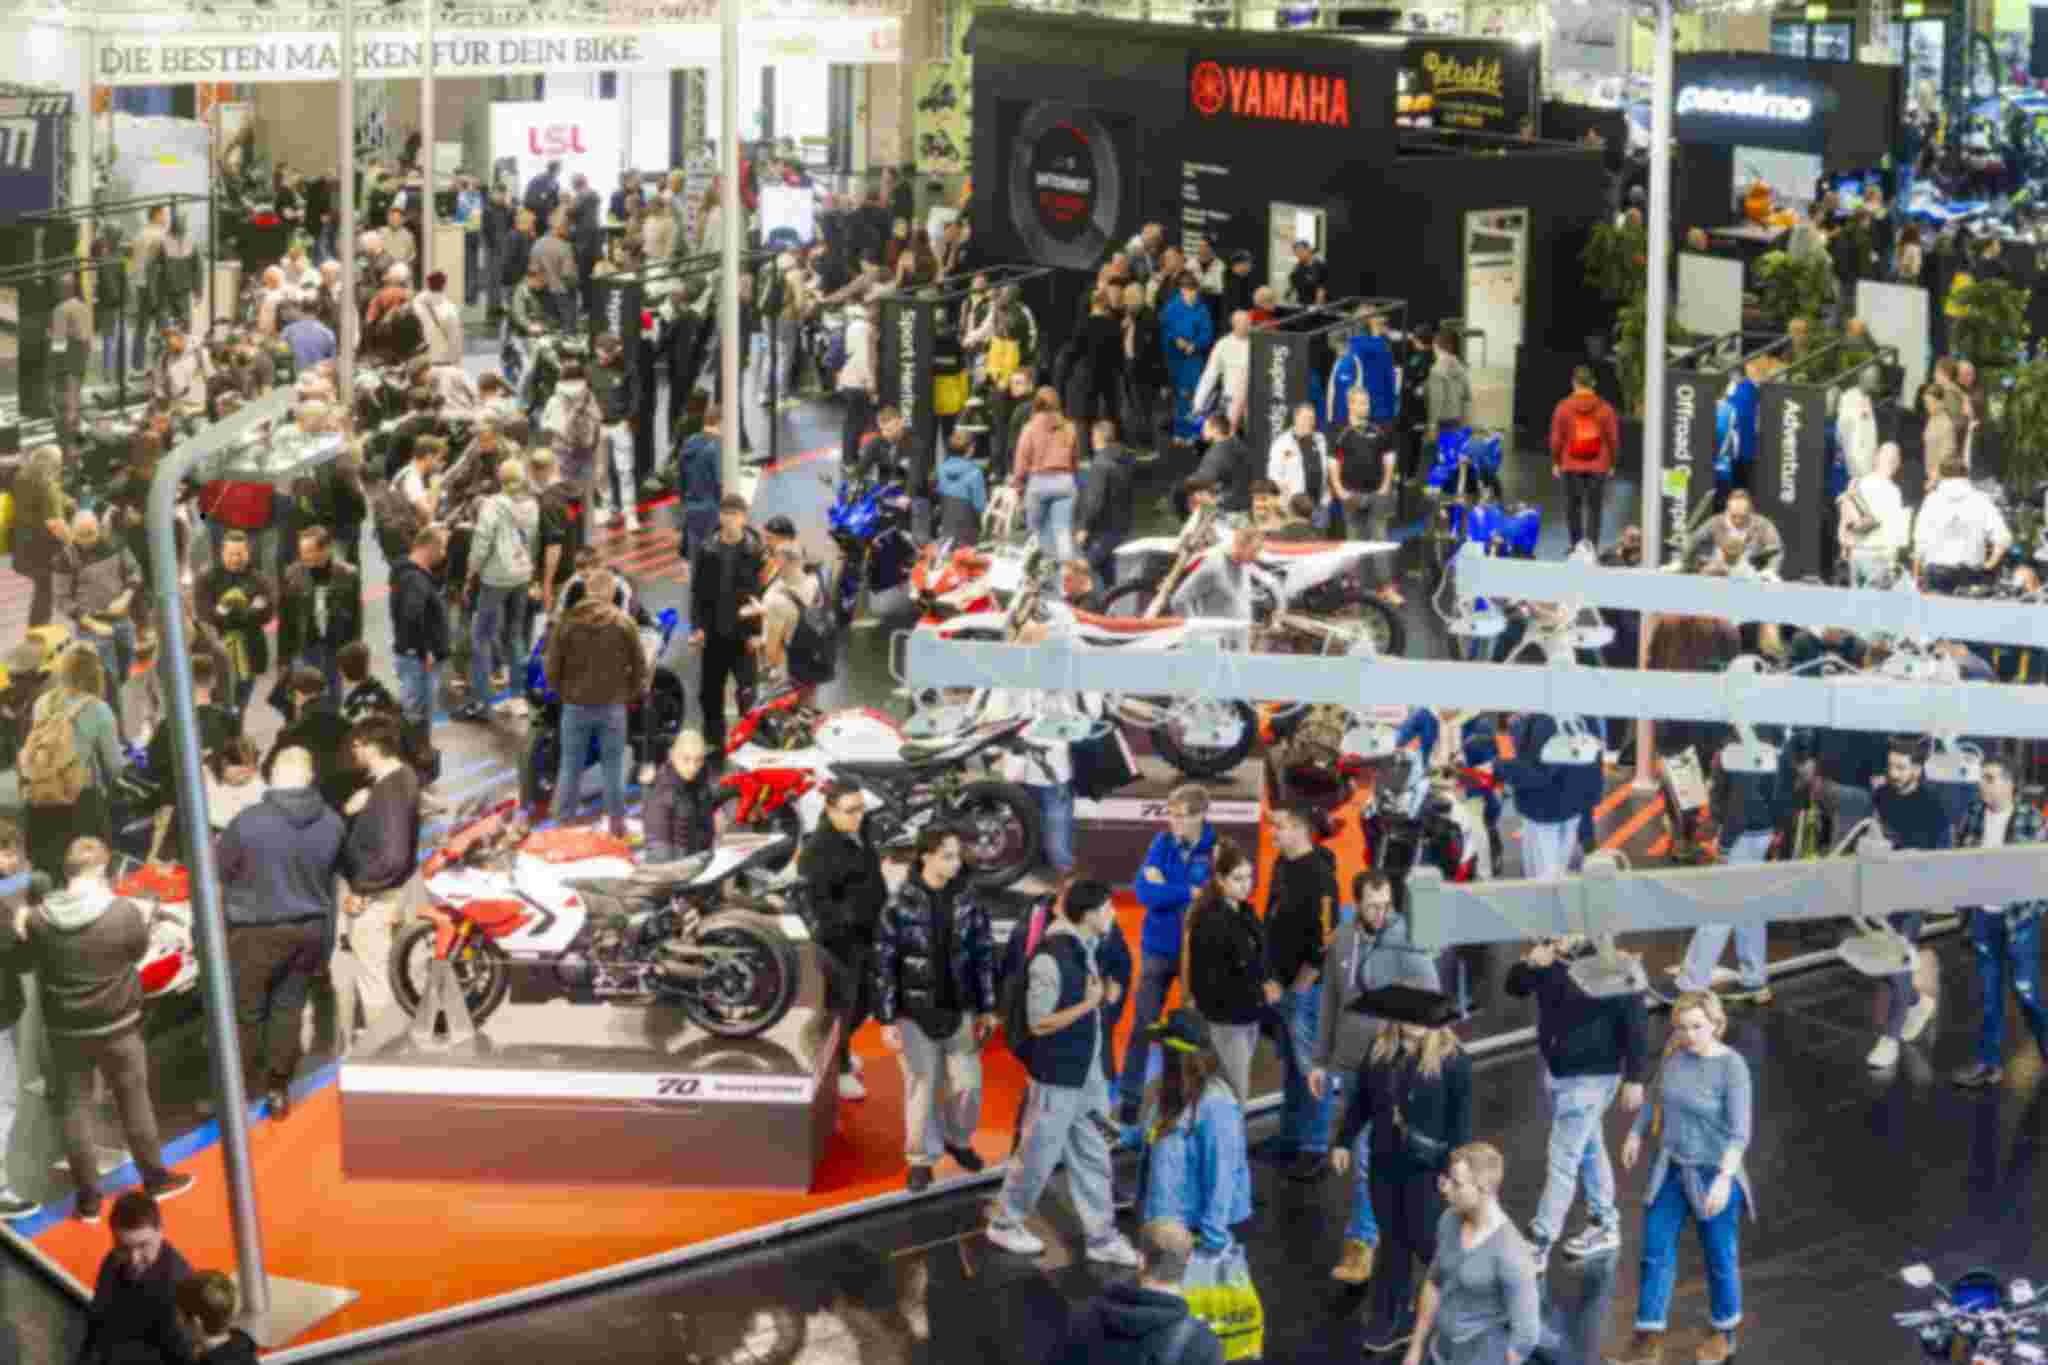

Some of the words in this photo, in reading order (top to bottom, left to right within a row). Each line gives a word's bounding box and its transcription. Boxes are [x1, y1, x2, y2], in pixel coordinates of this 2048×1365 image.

[99, 46, 151, 74] DIE
[160, 45, 278, 73] BESTEN
[431, 38, 491, 66] FÜR
[499, 38, 567, 65] DEIN
[1227, 66, 1350, 128] YAMAHA
[528, 124, 587, 154] LSL
[898, 310, 917, 358] Sport
[1268, 345, 1290, 399] Super
[1674, 384, 1695, 459] Offroad
[1780, 399, 1801, 503] Adventure
